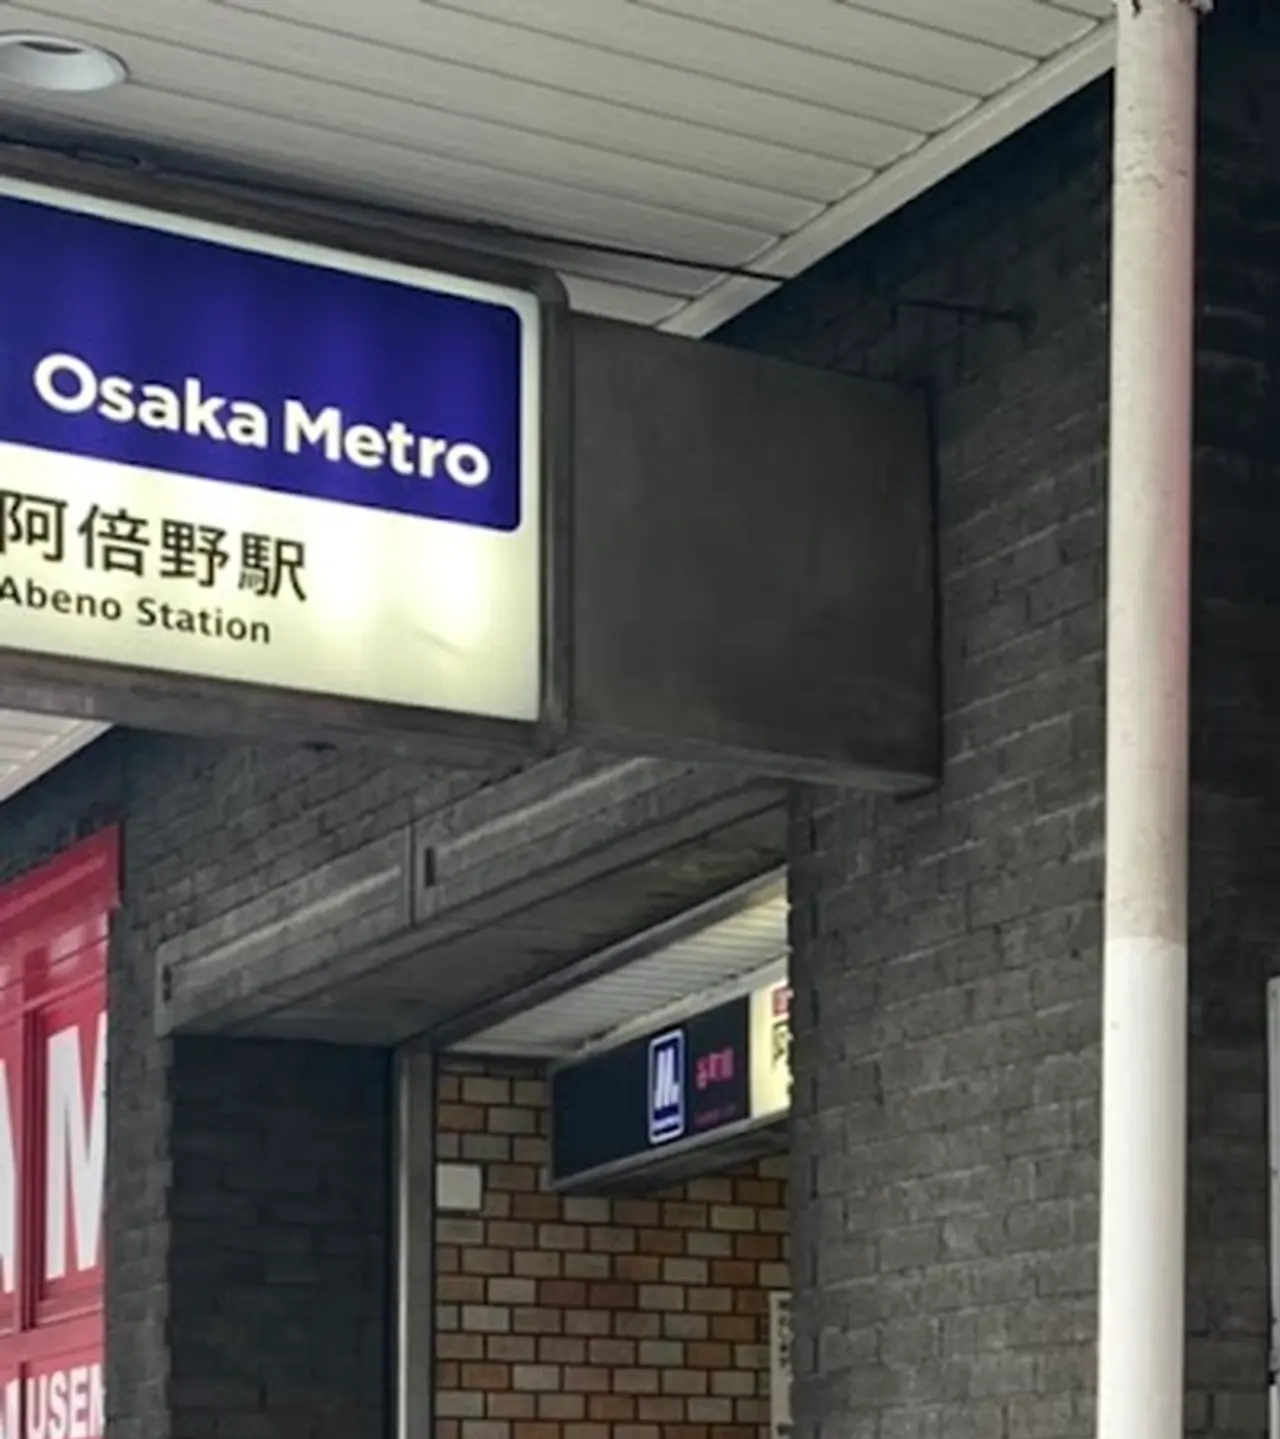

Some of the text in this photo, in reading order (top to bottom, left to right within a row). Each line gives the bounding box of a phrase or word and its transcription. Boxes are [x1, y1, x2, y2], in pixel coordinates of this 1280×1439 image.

[33, 352, 491, 488] Osaka Metro
[0, 488, 307, 602] 阿倍野駅
[0, 575, 271, 645] Abeno Station
